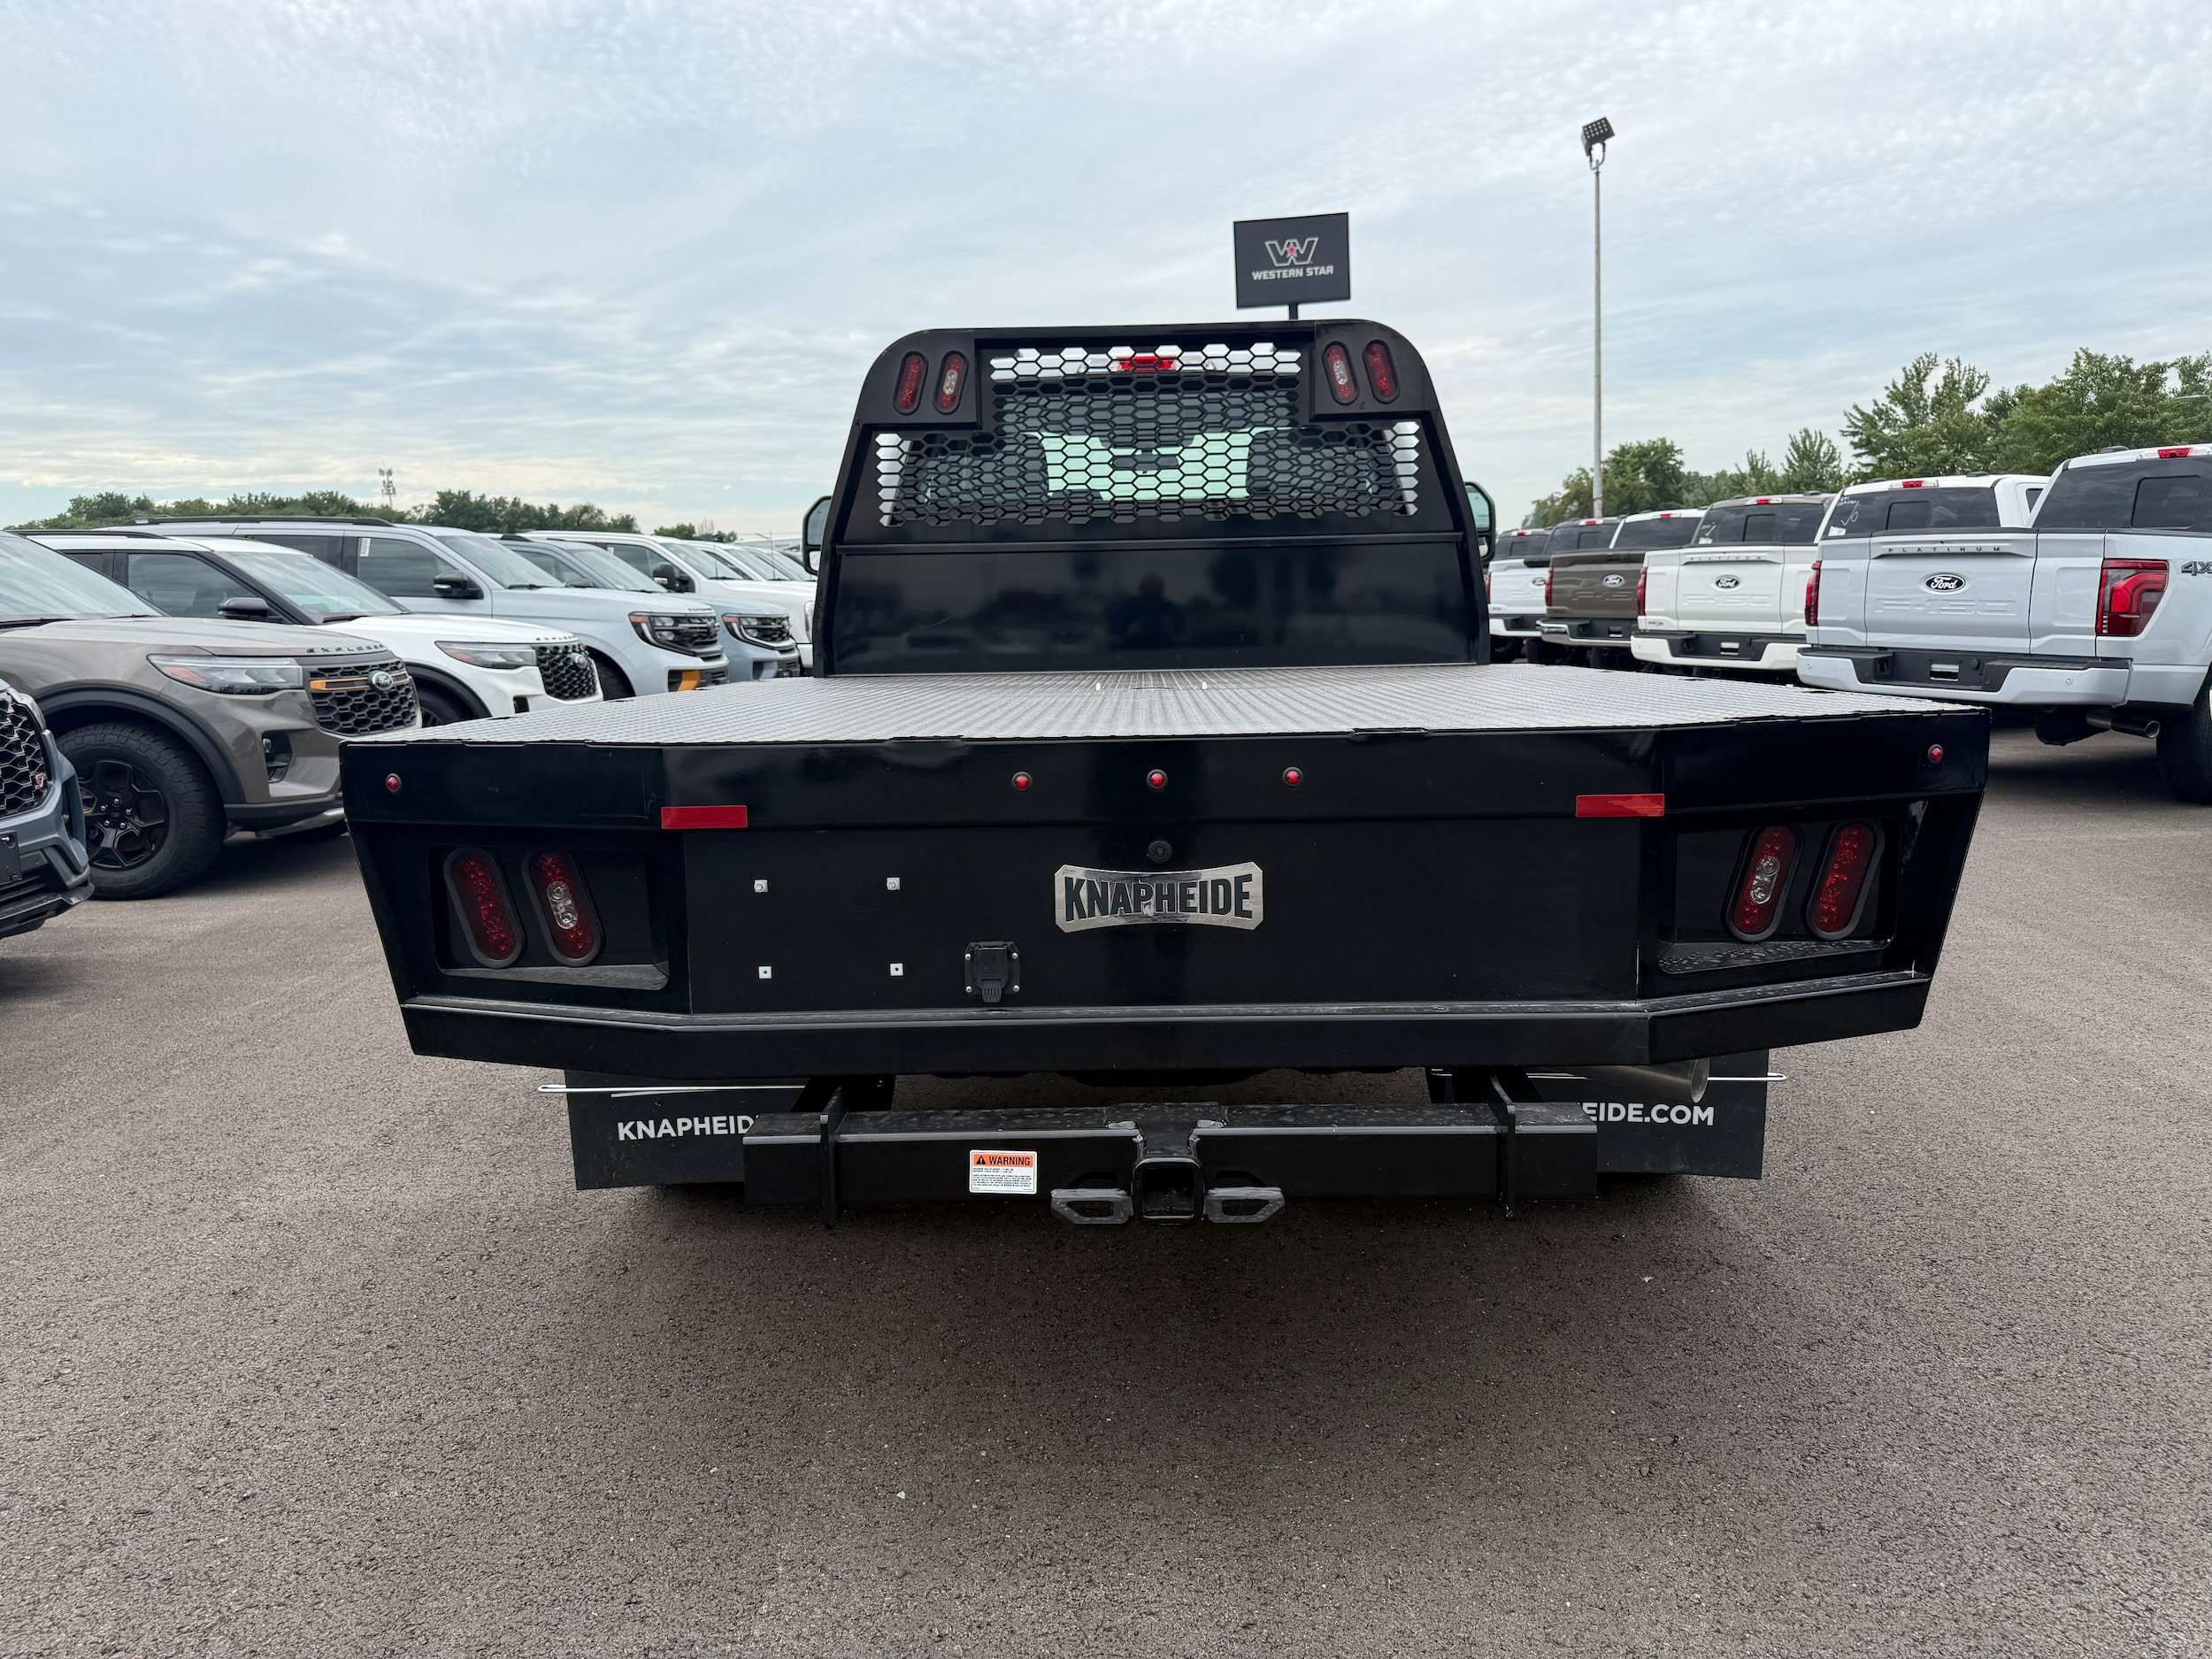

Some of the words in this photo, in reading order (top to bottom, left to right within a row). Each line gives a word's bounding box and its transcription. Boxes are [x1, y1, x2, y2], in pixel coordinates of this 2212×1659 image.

[1252, 267, 1304, 280] WESTERN
[1305, 265, 1334, 277] STAR
[1930, 575, 1958, 590] Ford
[1873, 597, 2018, 617] F-150
[1064, 873, 1253, 922] KNAPHEIDE
[617, 1114, 760, 1141] KNAPHEID
[988, 1156, 1031, 1166] WARNING
